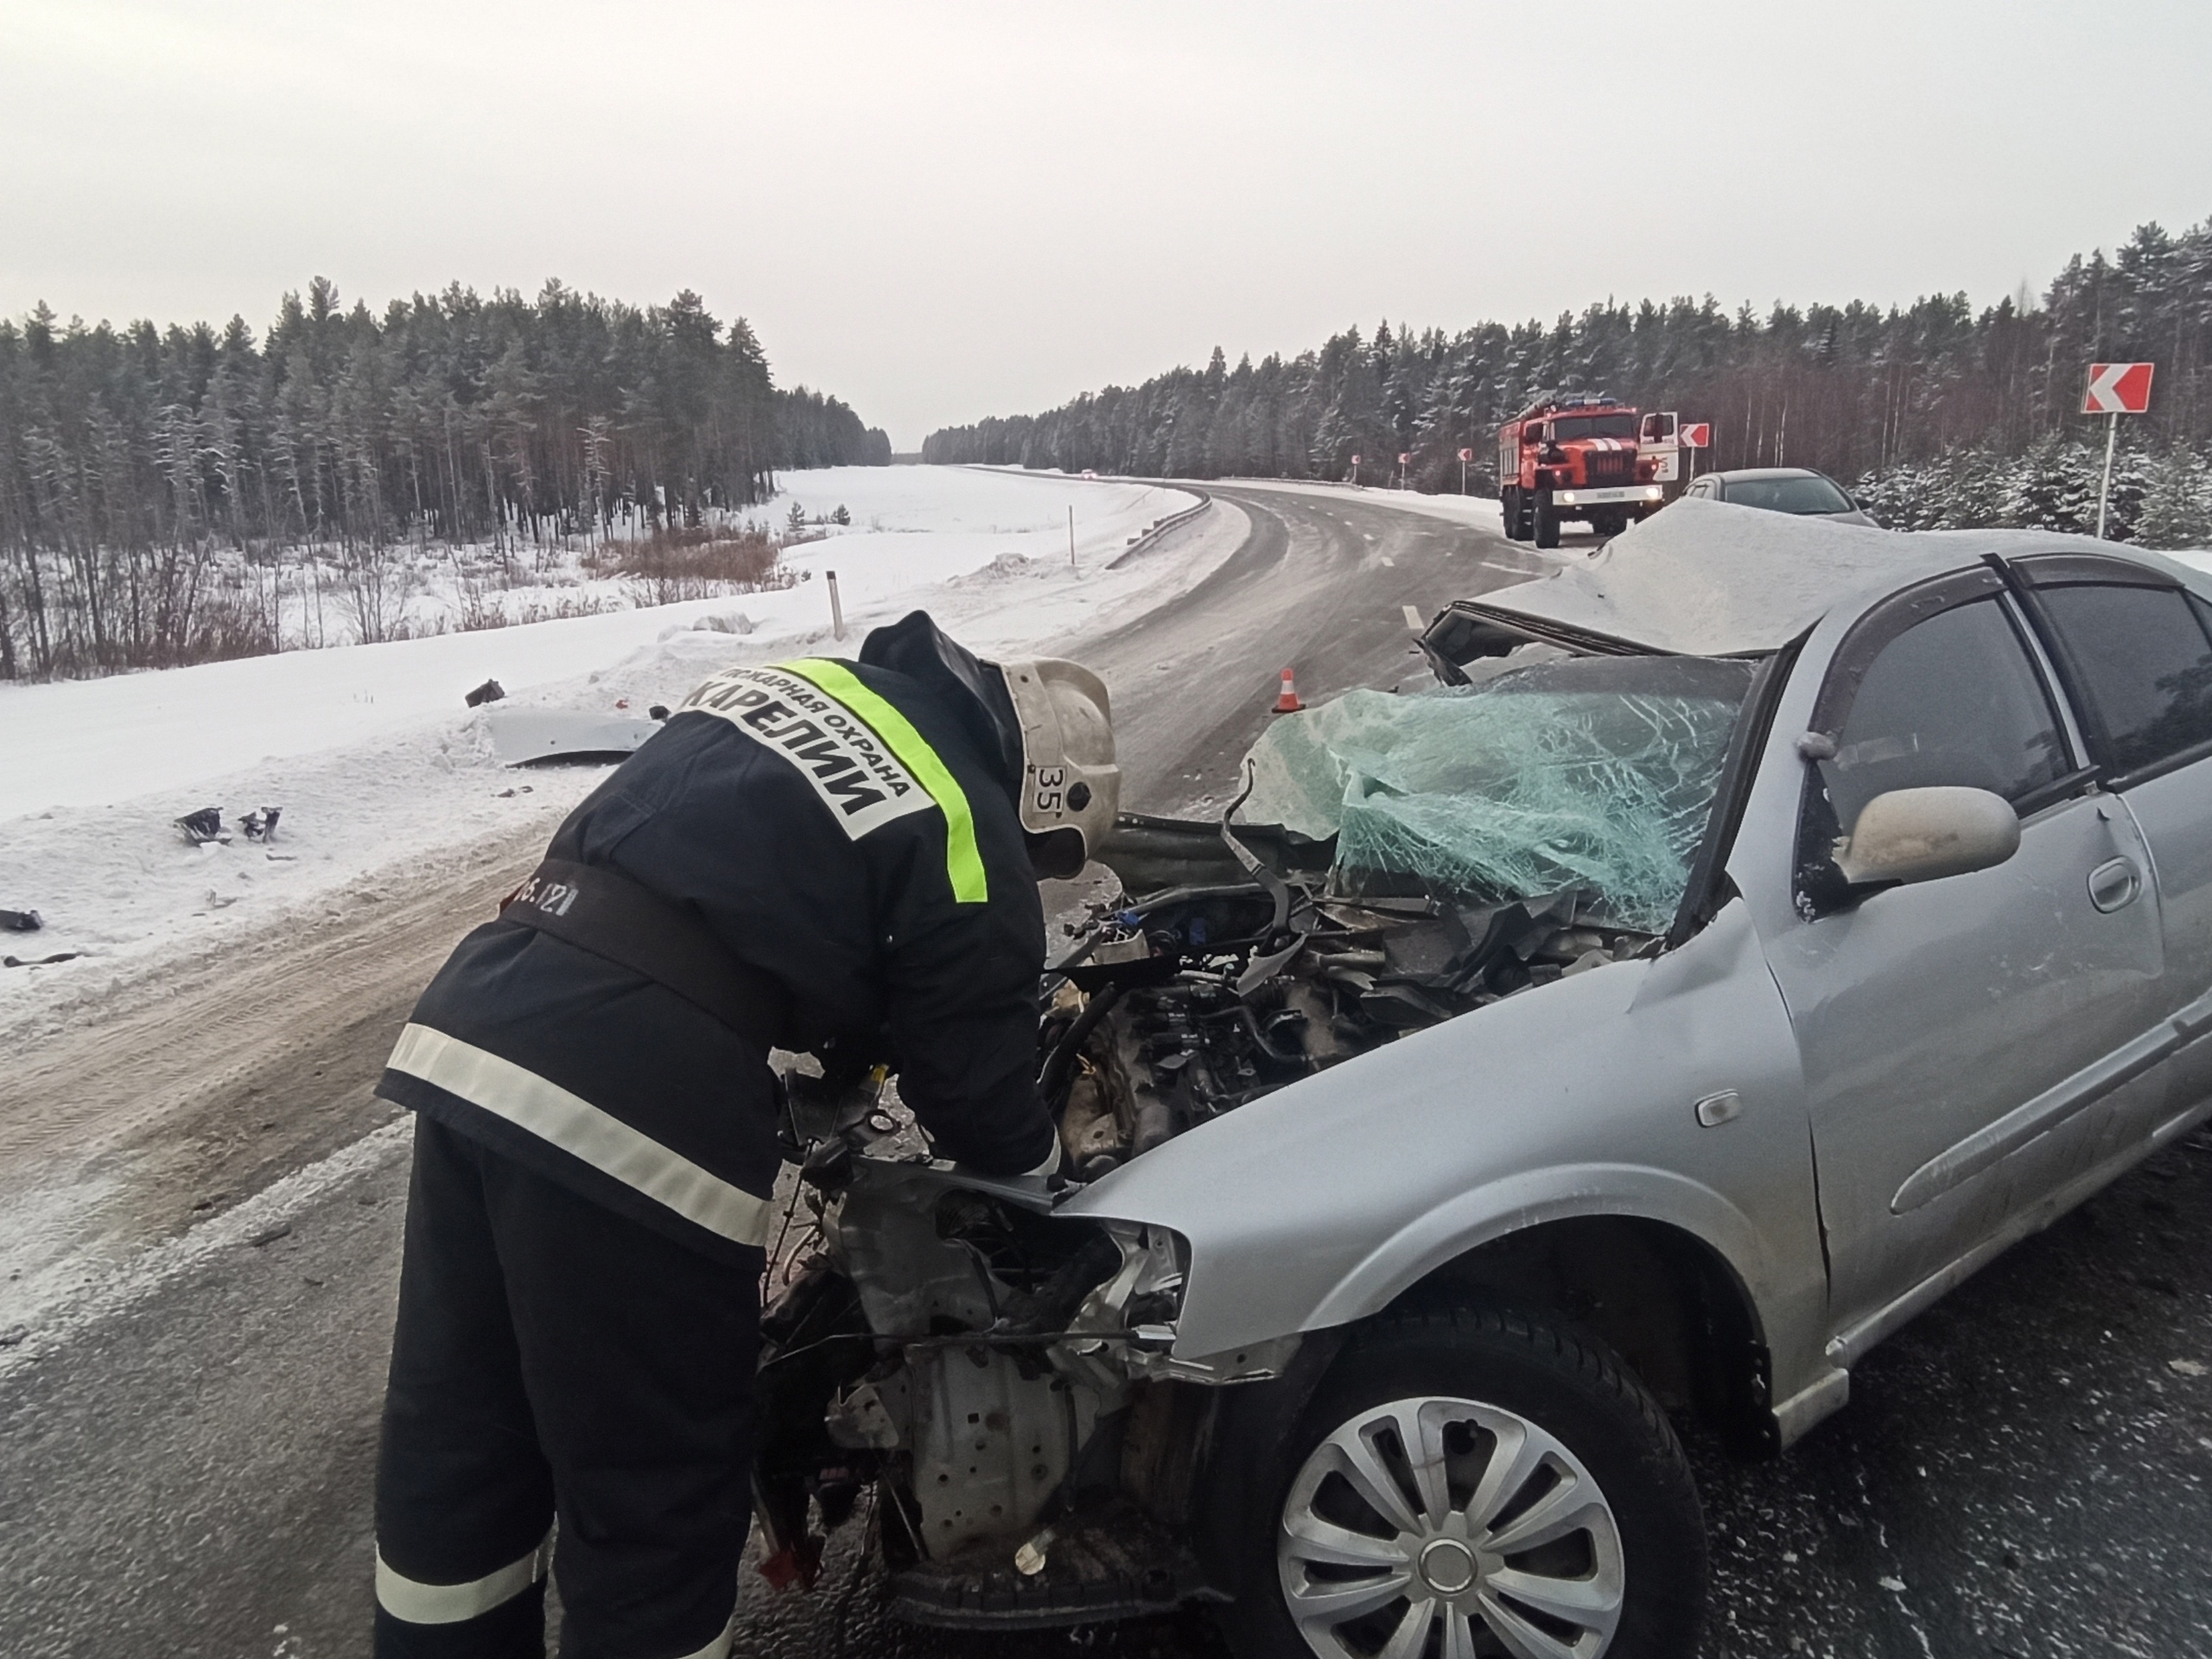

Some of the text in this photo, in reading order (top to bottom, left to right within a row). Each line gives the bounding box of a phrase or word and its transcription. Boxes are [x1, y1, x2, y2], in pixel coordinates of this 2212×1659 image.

[679, 681, 887, 816] КАРЕЛИИ
[720, 669, 910, 798] ПОЖАРНАЯ ОХРАНА
[1038, 769, 1063, 810] 35
